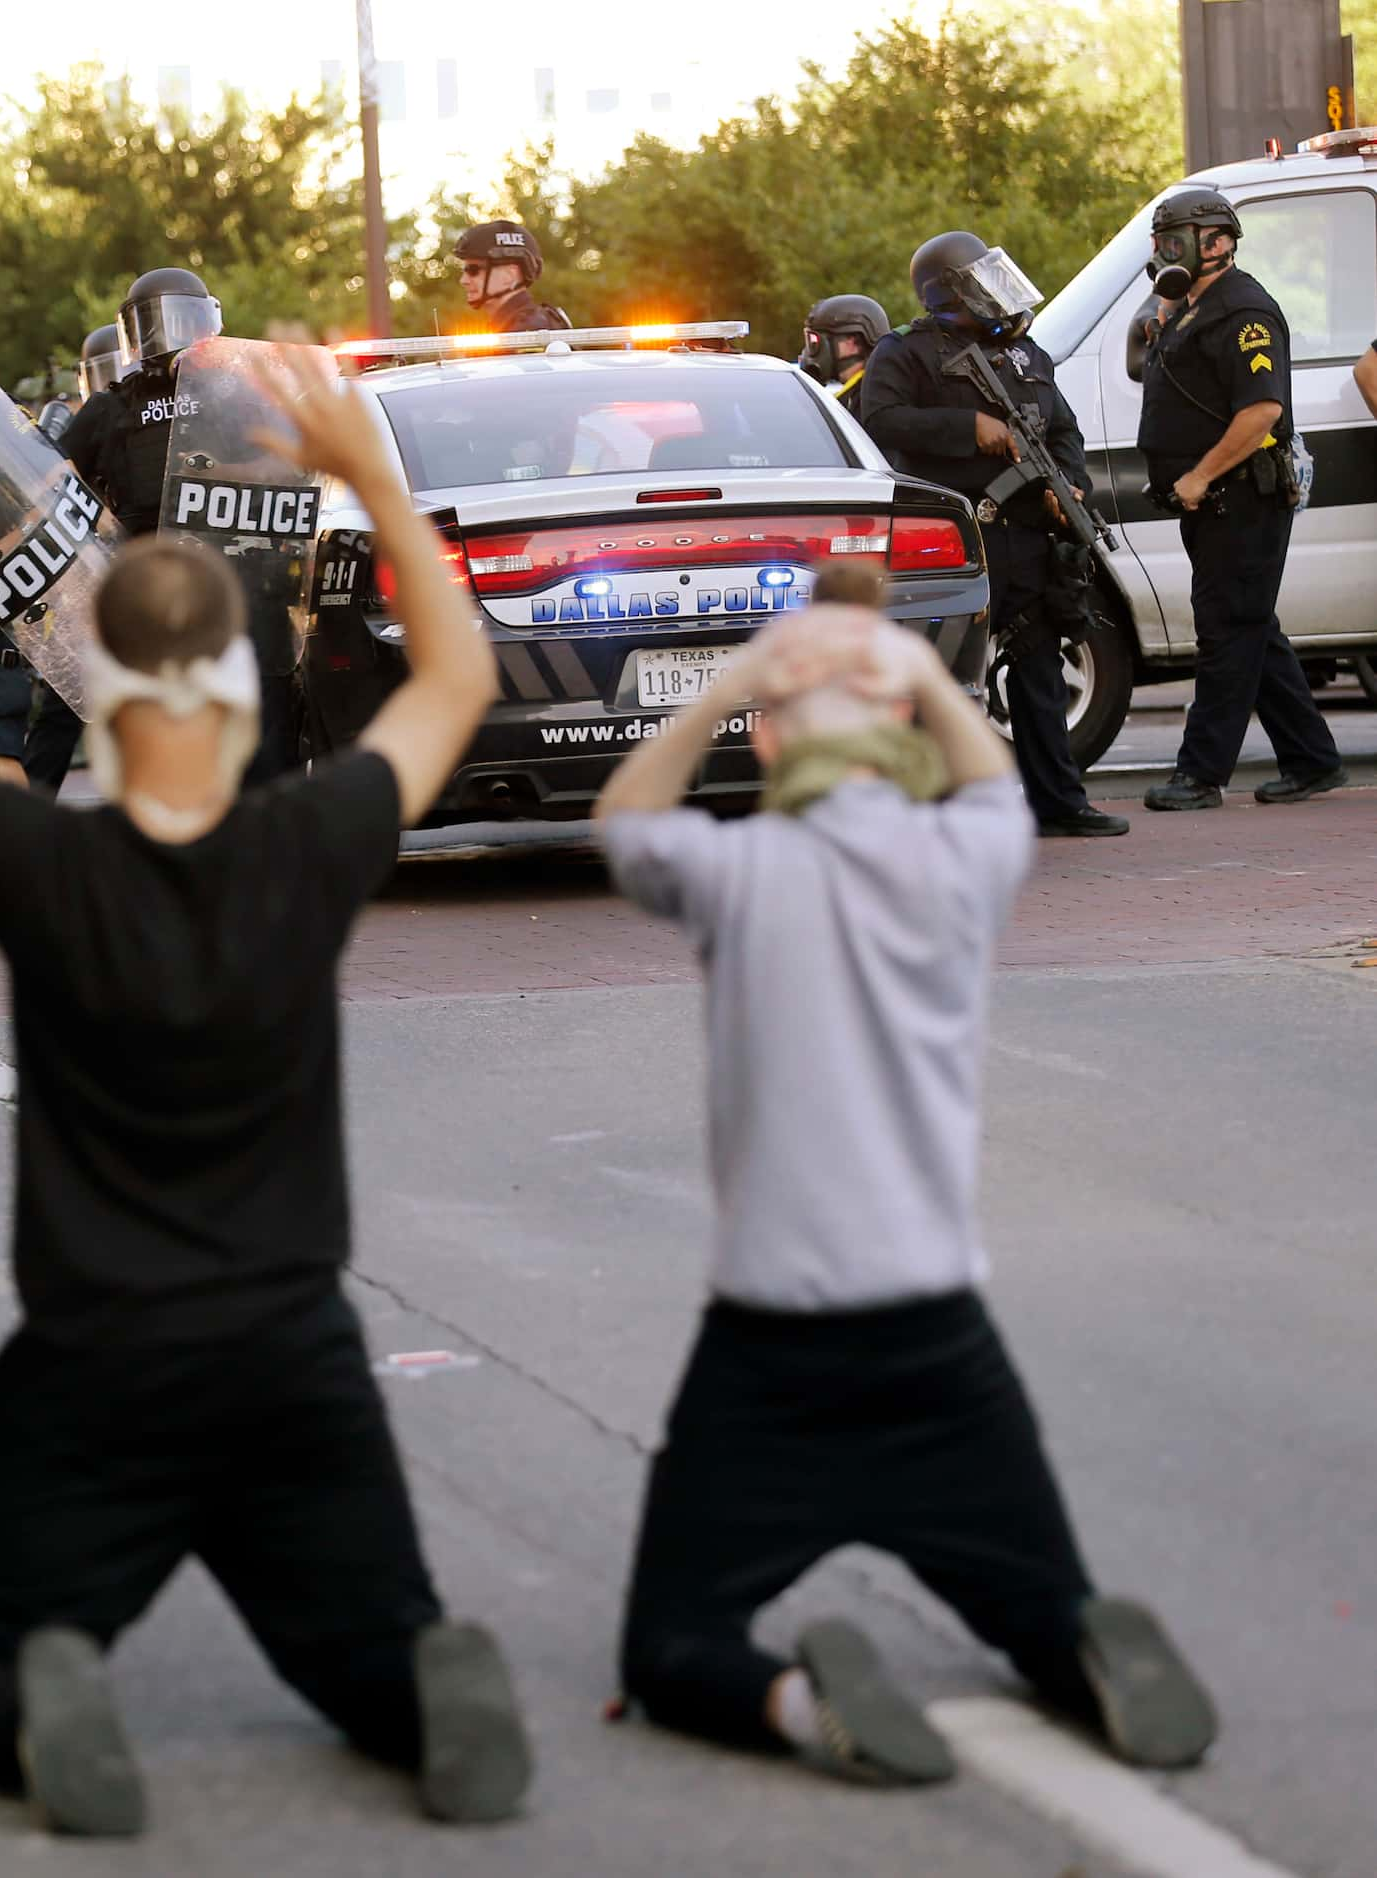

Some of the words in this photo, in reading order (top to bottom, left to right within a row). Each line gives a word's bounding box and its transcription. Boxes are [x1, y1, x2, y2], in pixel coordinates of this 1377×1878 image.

[495, 233, 526, 246] POLICE
[147, 393, 191, 410] DALLAS
[141, 401, 199, 424] POLICE
[176, 482, 314, 534] POLICE
[599, 533, 766, 549] DODGE
[532, 591, 680, 623] DALLAS
[697, 585, 811, 613] POLIC
[671, 650, 715, 662] TEXAS
